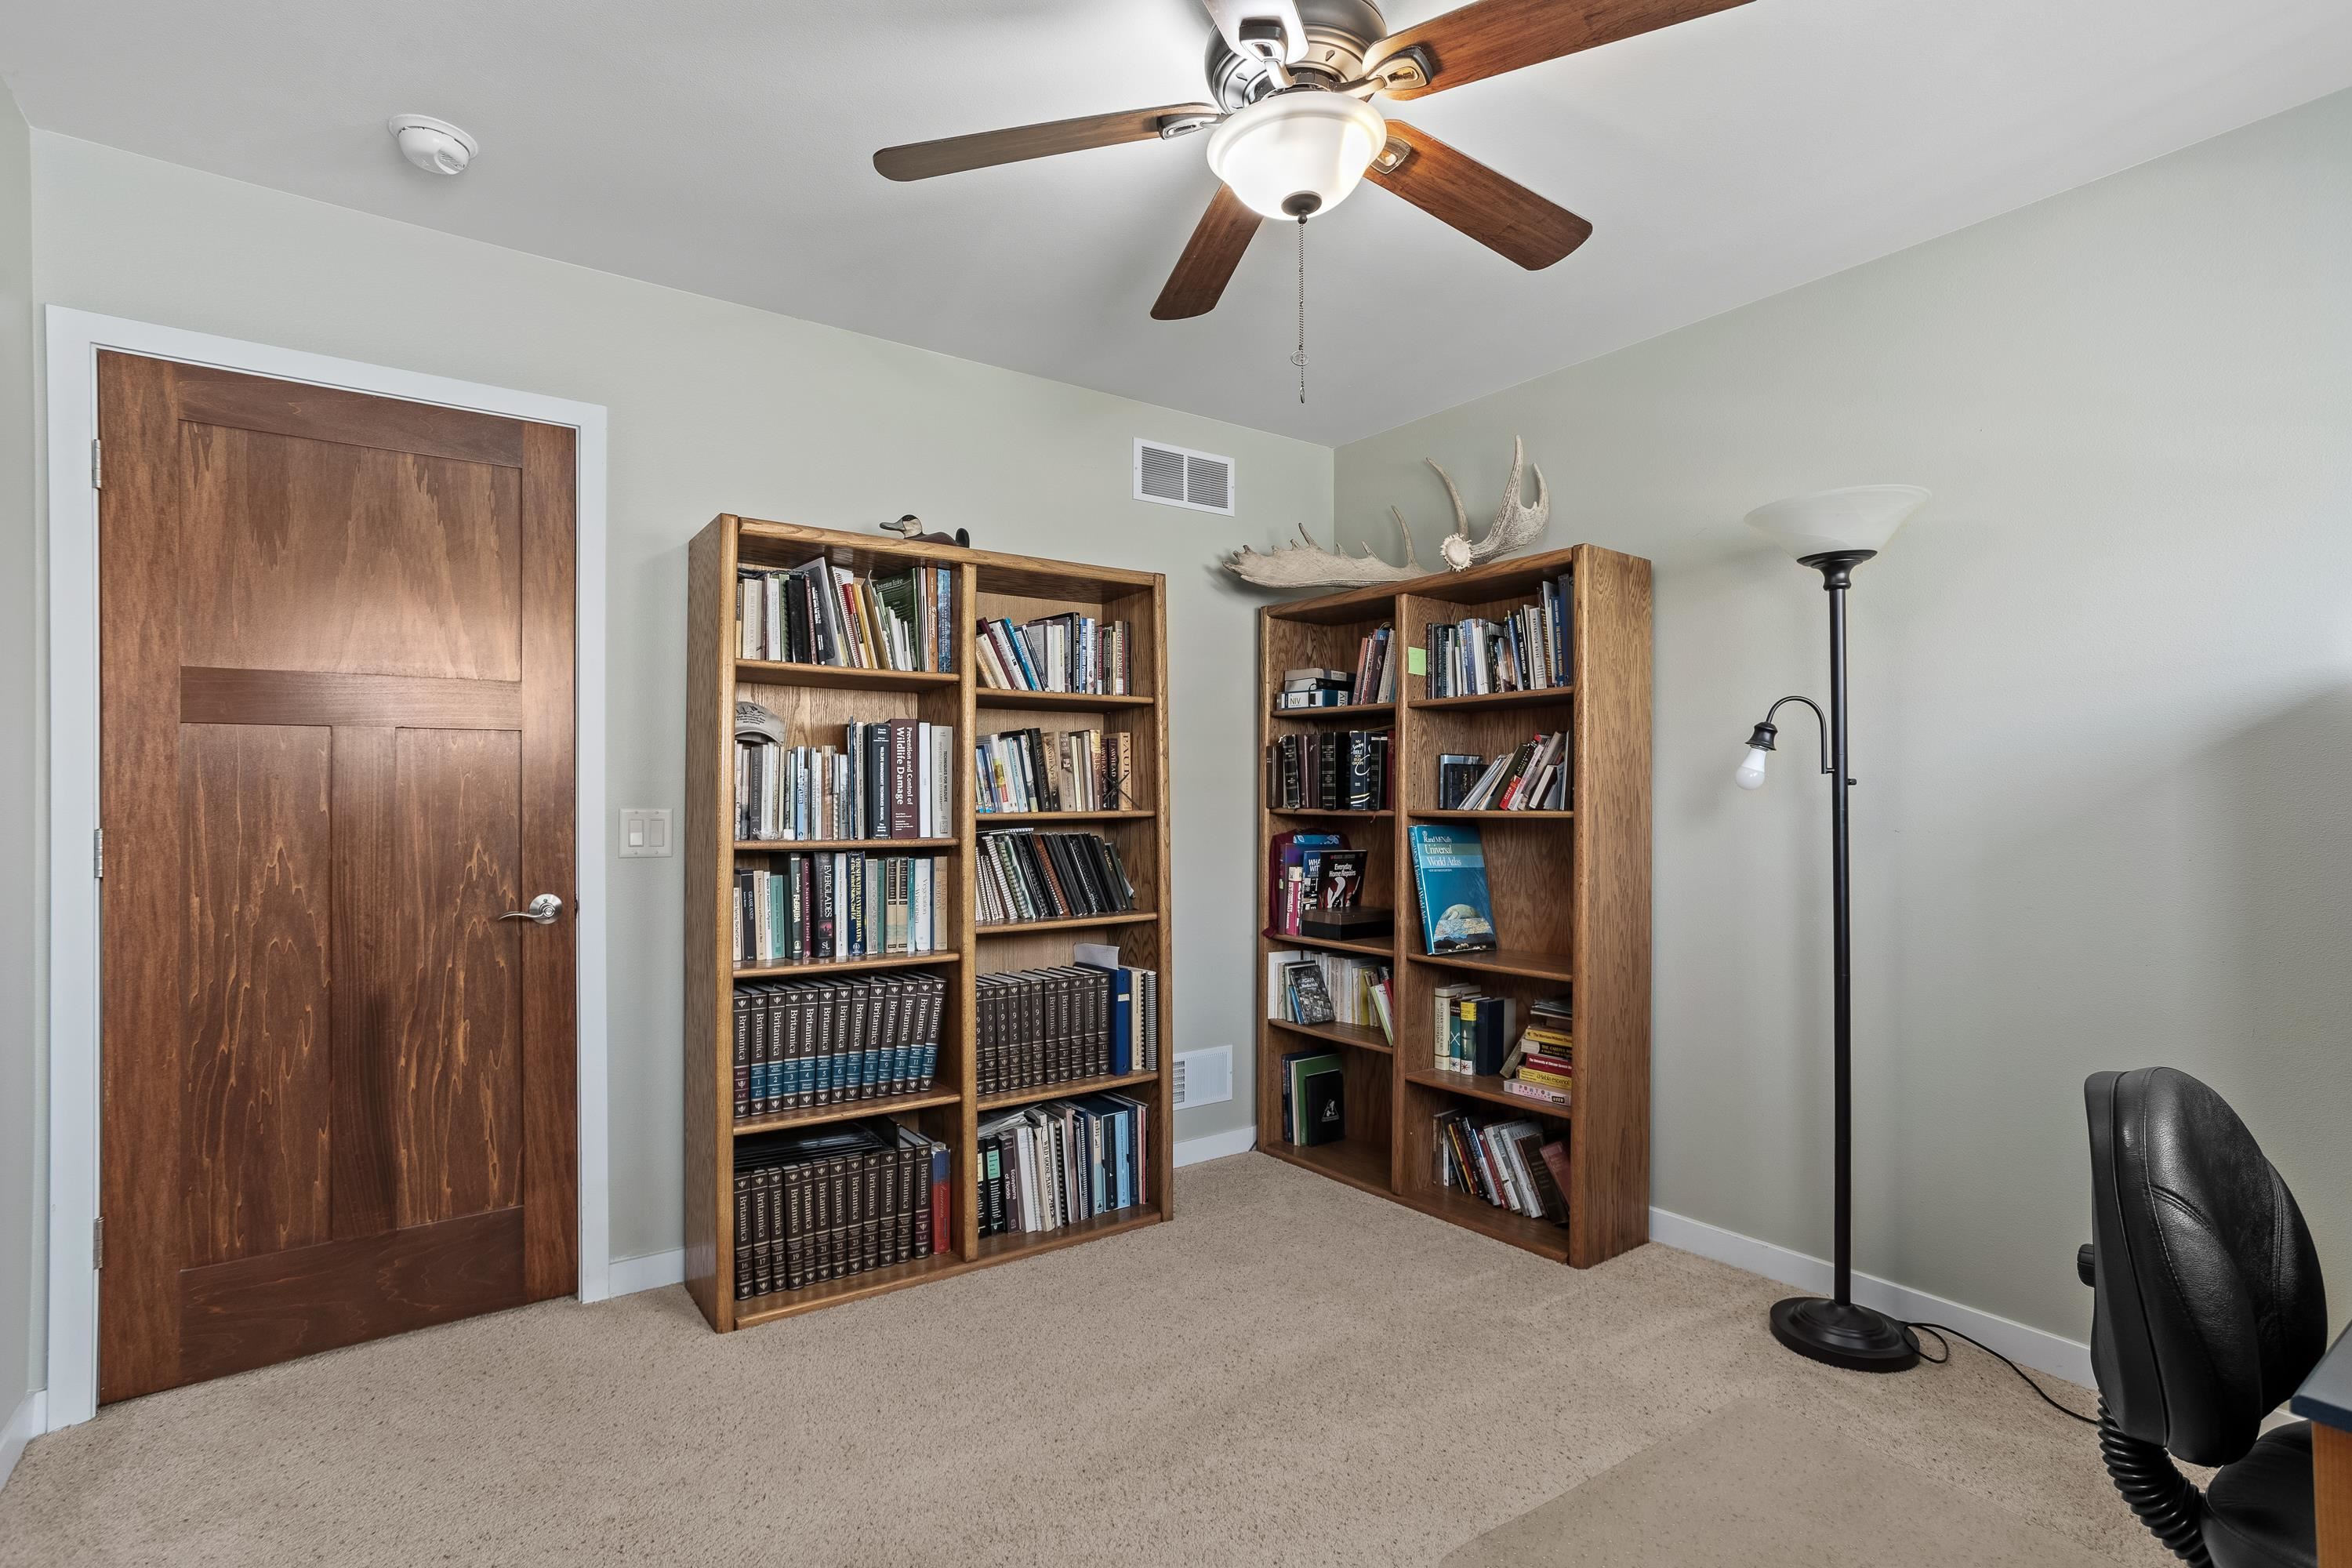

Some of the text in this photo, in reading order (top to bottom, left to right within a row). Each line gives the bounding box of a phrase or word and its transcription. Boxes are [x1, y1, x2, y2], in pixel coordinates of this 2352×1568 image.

[896, 727, 905, 764] Wildlife
[895, 767, 904, 805] Damage
[1334, 863, 1352, 872] Everyday
[1425, 845, 1453, 855] Universal
[1447, 857, 1461, 866] Atlas
[823, 865, 832, 917] EVERGLADES
[805, 1008, 814, 1052] Britannica
[822, 1007, 831, 1051] Britannica
[838, 1005, 848, 1048] Britannica
[854, 1004, 864, 1047] Britannica
[871, 1002, 881, 1044] Britannica
[886, 1000, 898, 1043] Britannica
[902, 1000, 913, 1041] Britannica
[916, 999, 927, 1040] Britannica
[930, 997, 942, 1039] Britannica
[739, 1195, 747, 1243] Britannica
[774, 1189, 782, 1236] Britannica
[818, 1182, 827, 1227] Britannica
